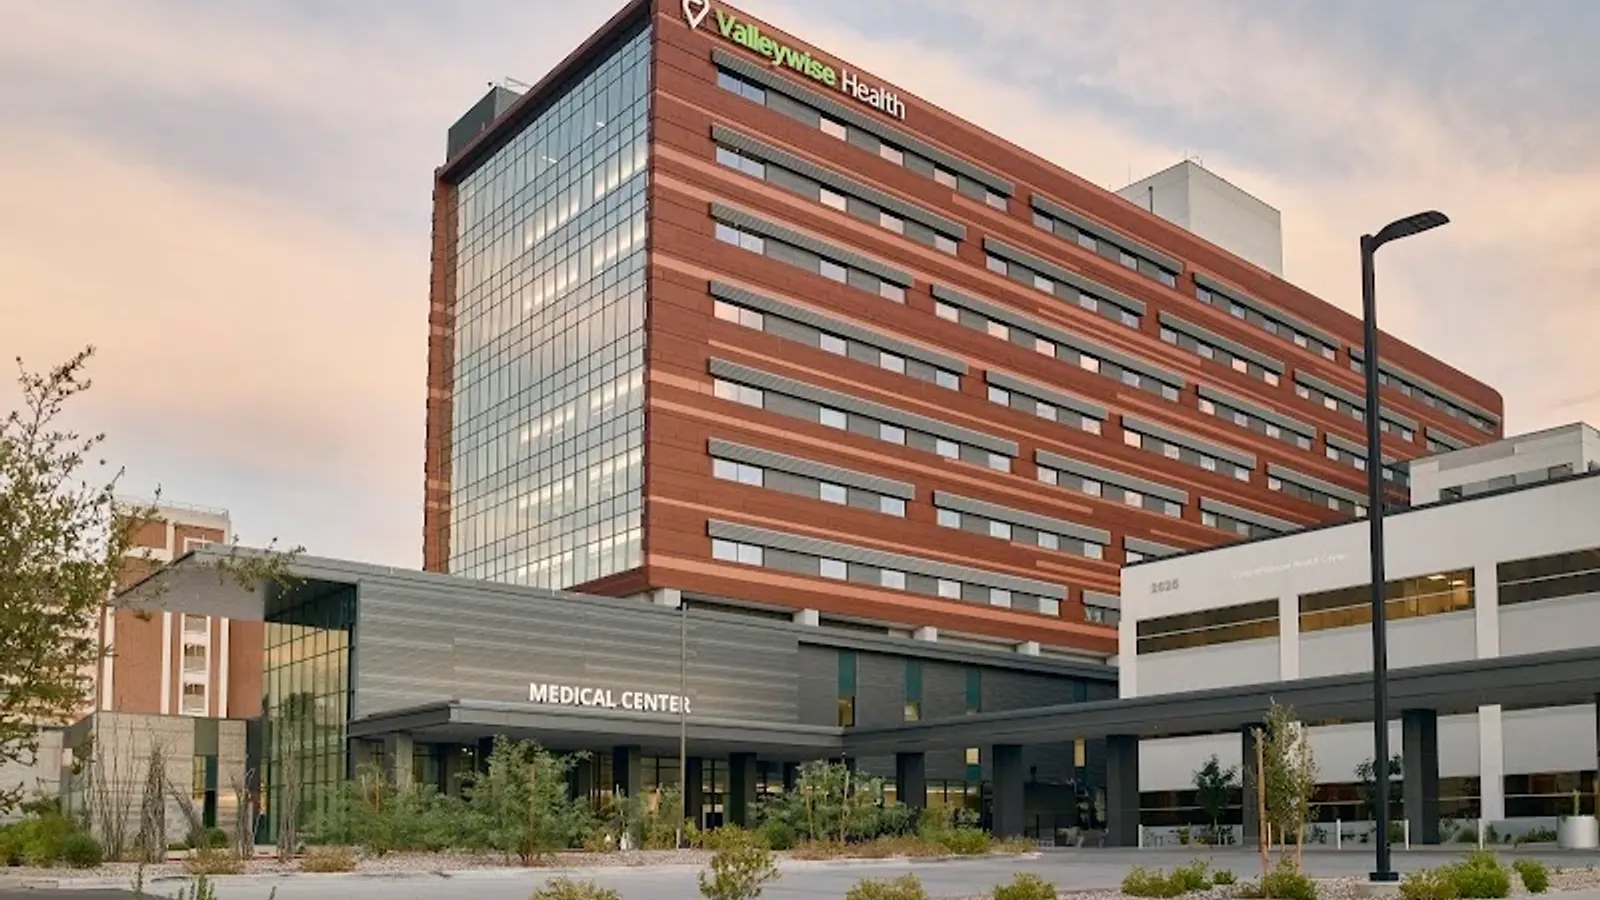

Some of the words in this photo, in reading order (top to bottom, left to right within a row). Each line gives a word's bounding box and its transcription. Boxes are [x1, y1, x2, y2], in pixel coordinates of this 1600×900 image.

[715, 8, 837, 86] Valleywise
[841, 69, 906, 120] Health
[529, 683, 617, 708] MEDICAL
[621, 691, 692, 713] CENTER
